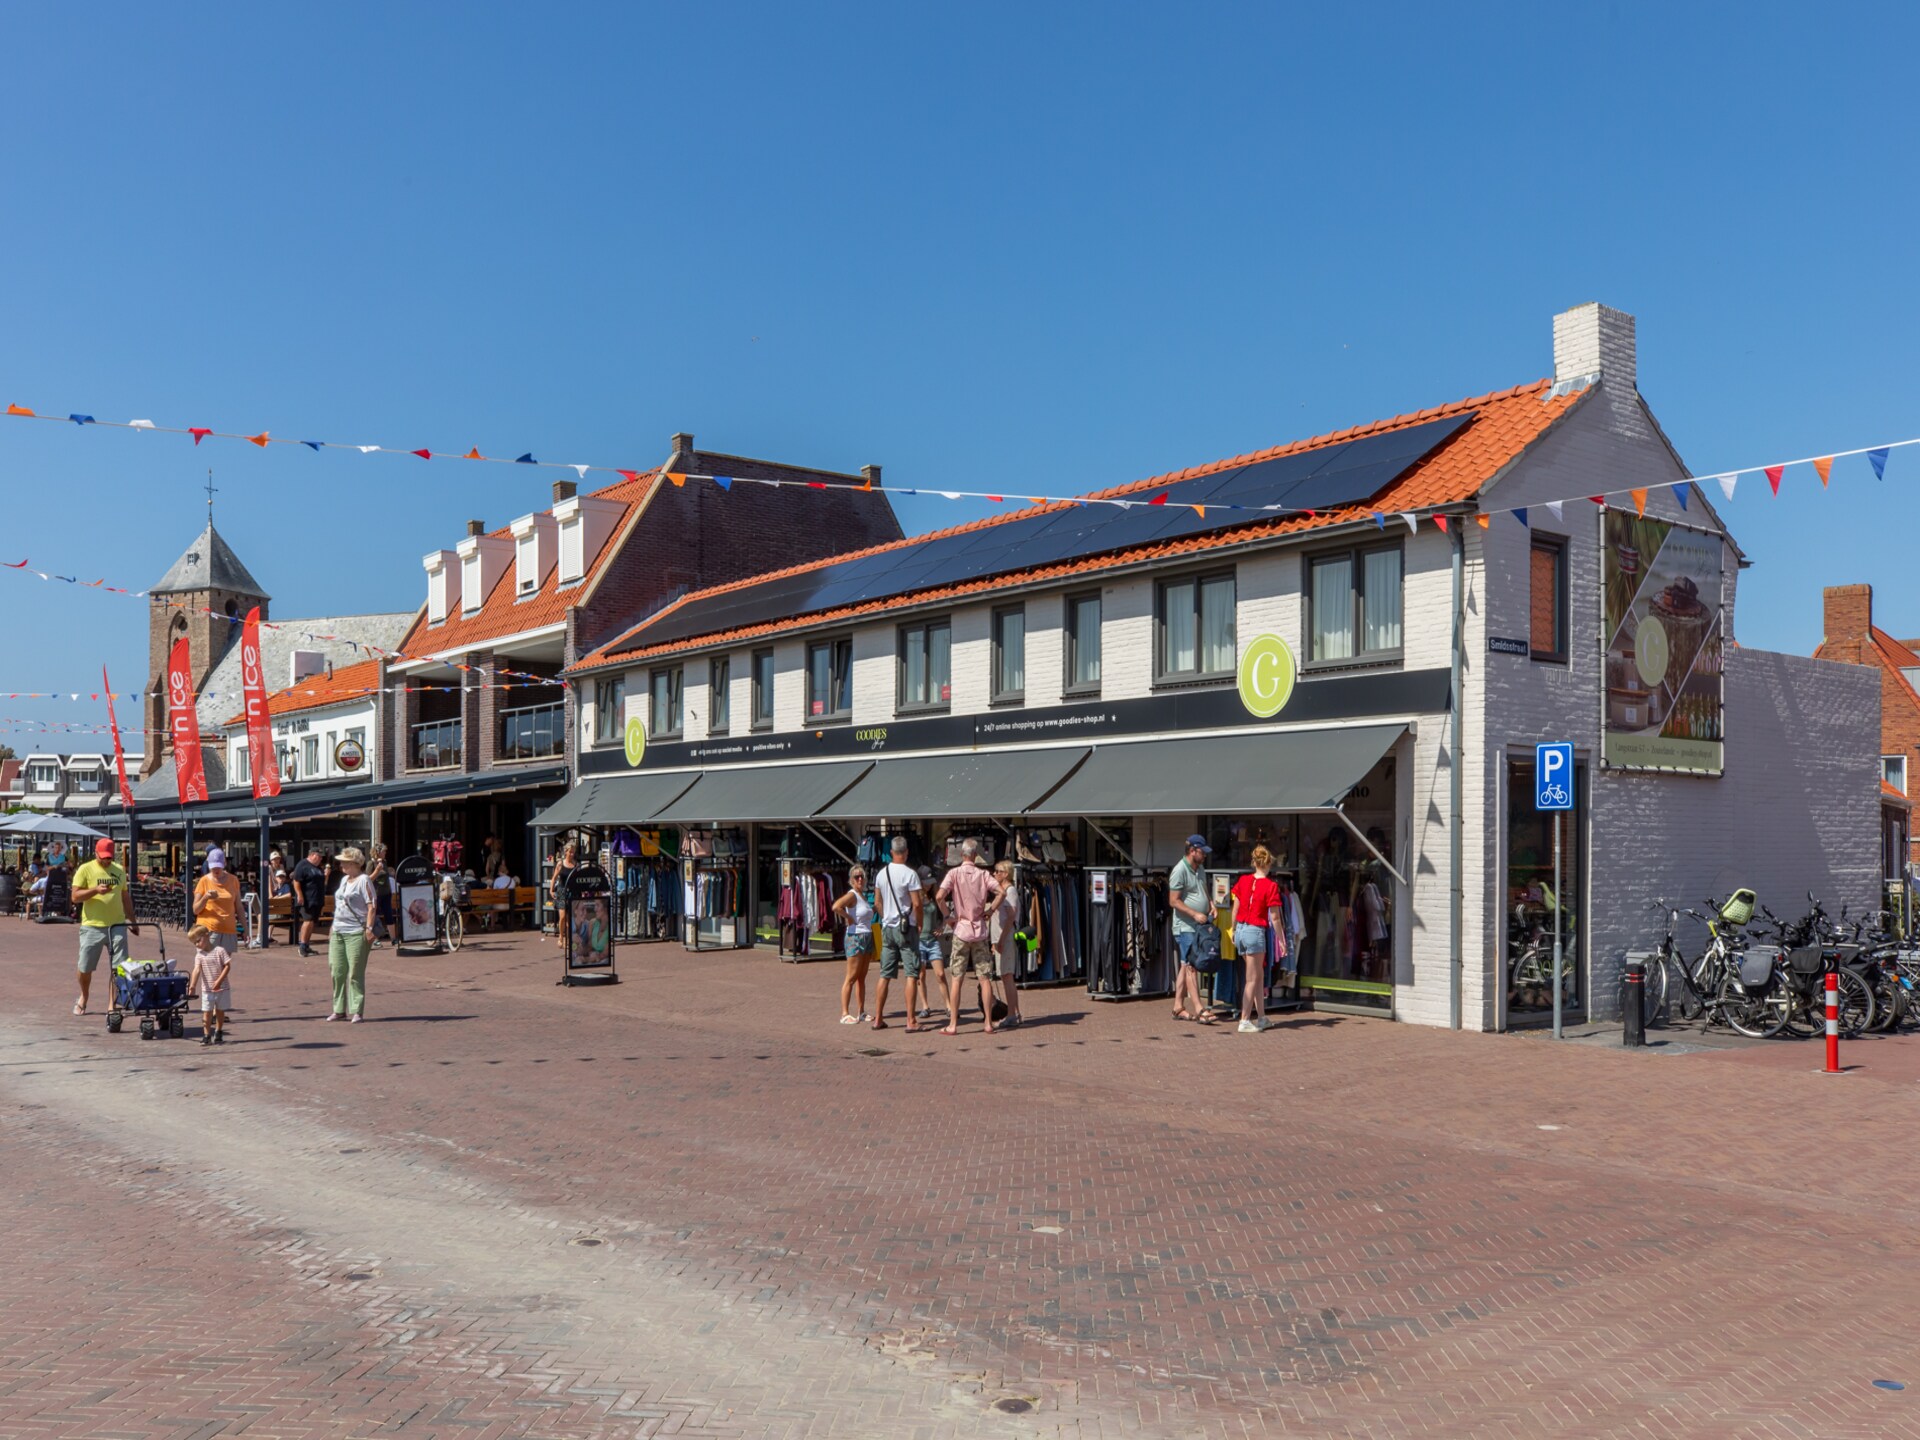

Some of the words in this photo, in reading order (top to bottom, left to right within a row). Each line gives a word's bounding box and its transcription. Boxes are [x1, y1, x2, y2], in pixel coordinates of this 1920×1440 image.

[1490, 639, 1527, 653] Smidsstraat
[243, 645, 260, 690] Ice
[1252, 651, 1281, 699] G
[169, 671, 187, 710] Ice
[856, 728, 887, 741] GOODIES
[984, 723, 995, 732] 24/7
[995, 722, 1011, 731] online
[1012, 720, 1036, 730] shopping
[1037, 720, 1044, 728] op
[1044, 714, 1105, 727] www.goodies-shop.nl
[629, 726, 640, 756] G
[1544, 750, 1564, 783] P
